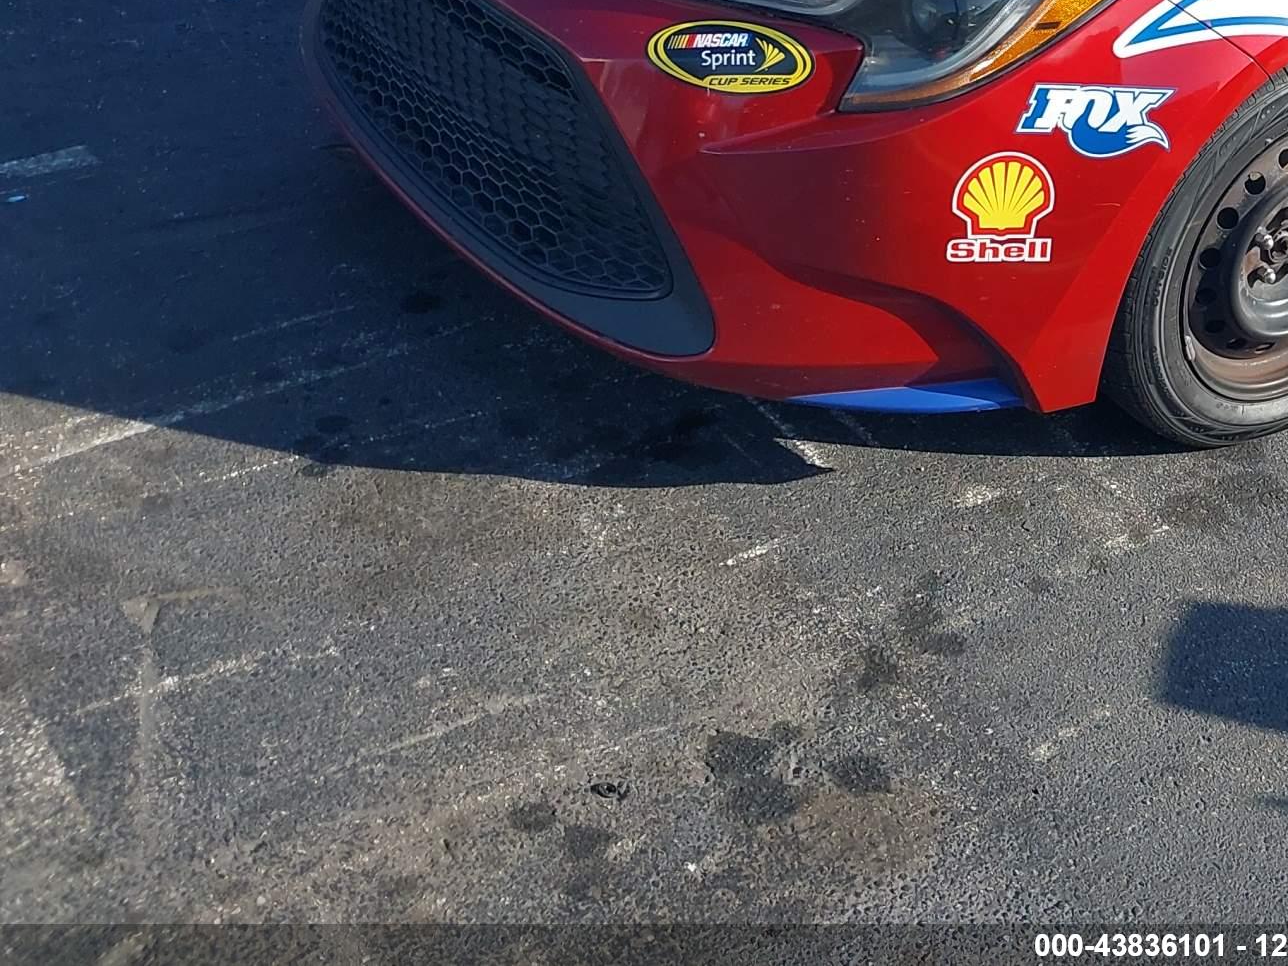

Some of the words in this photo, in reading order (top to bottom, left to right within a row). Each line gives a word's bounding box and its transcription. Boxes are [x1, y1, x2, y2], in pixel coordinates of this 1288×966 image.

[693, 33, 748, 48] NASCAR
[701, 50, 756, 71] Sprint
[709, 77, 739, 86] CUP
[741, 77, 792, 86] SERIES
[1017, 86, 1173, 151] FOX
[948, 239, 1051, 261] Shell
